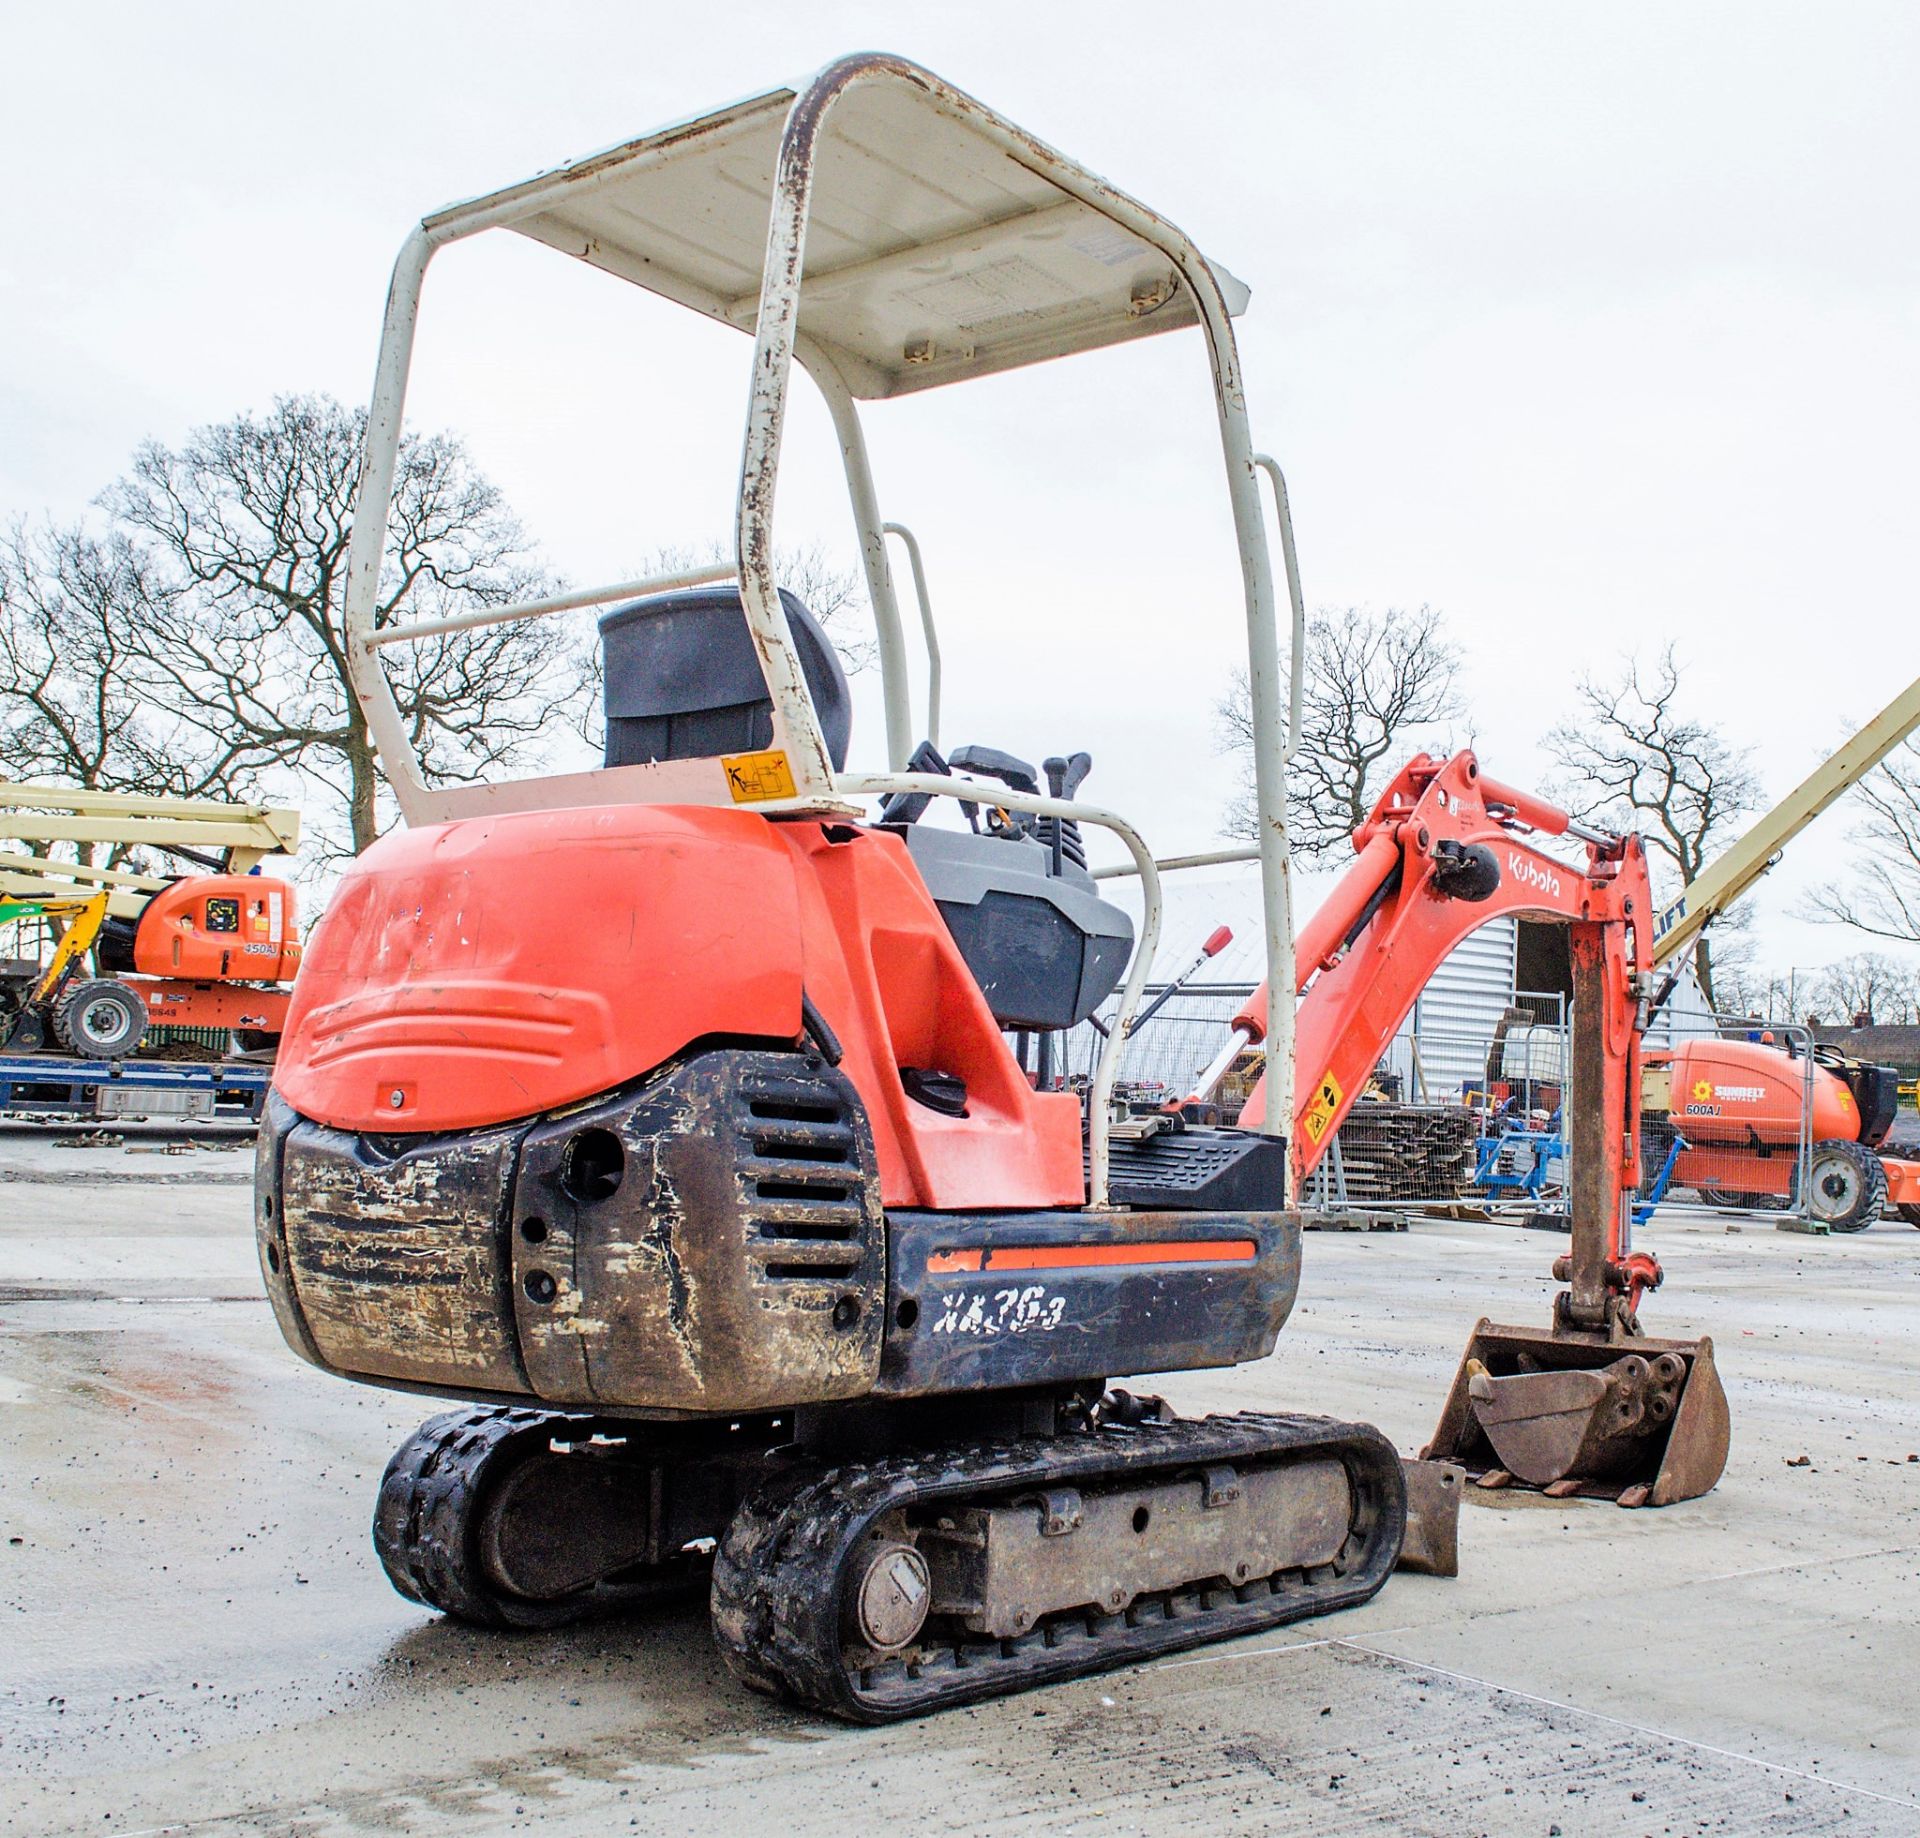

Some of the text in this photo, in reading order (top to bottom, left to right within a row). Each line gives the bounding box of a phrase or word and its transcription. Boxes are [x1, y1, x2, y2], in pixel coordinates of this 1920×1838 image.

[1508, 851, 1560, 898] Kubota
[1714, 1085, 1766, 1099] SUNBELT
[1686, 1104, 1721, 1116] 600AJ
